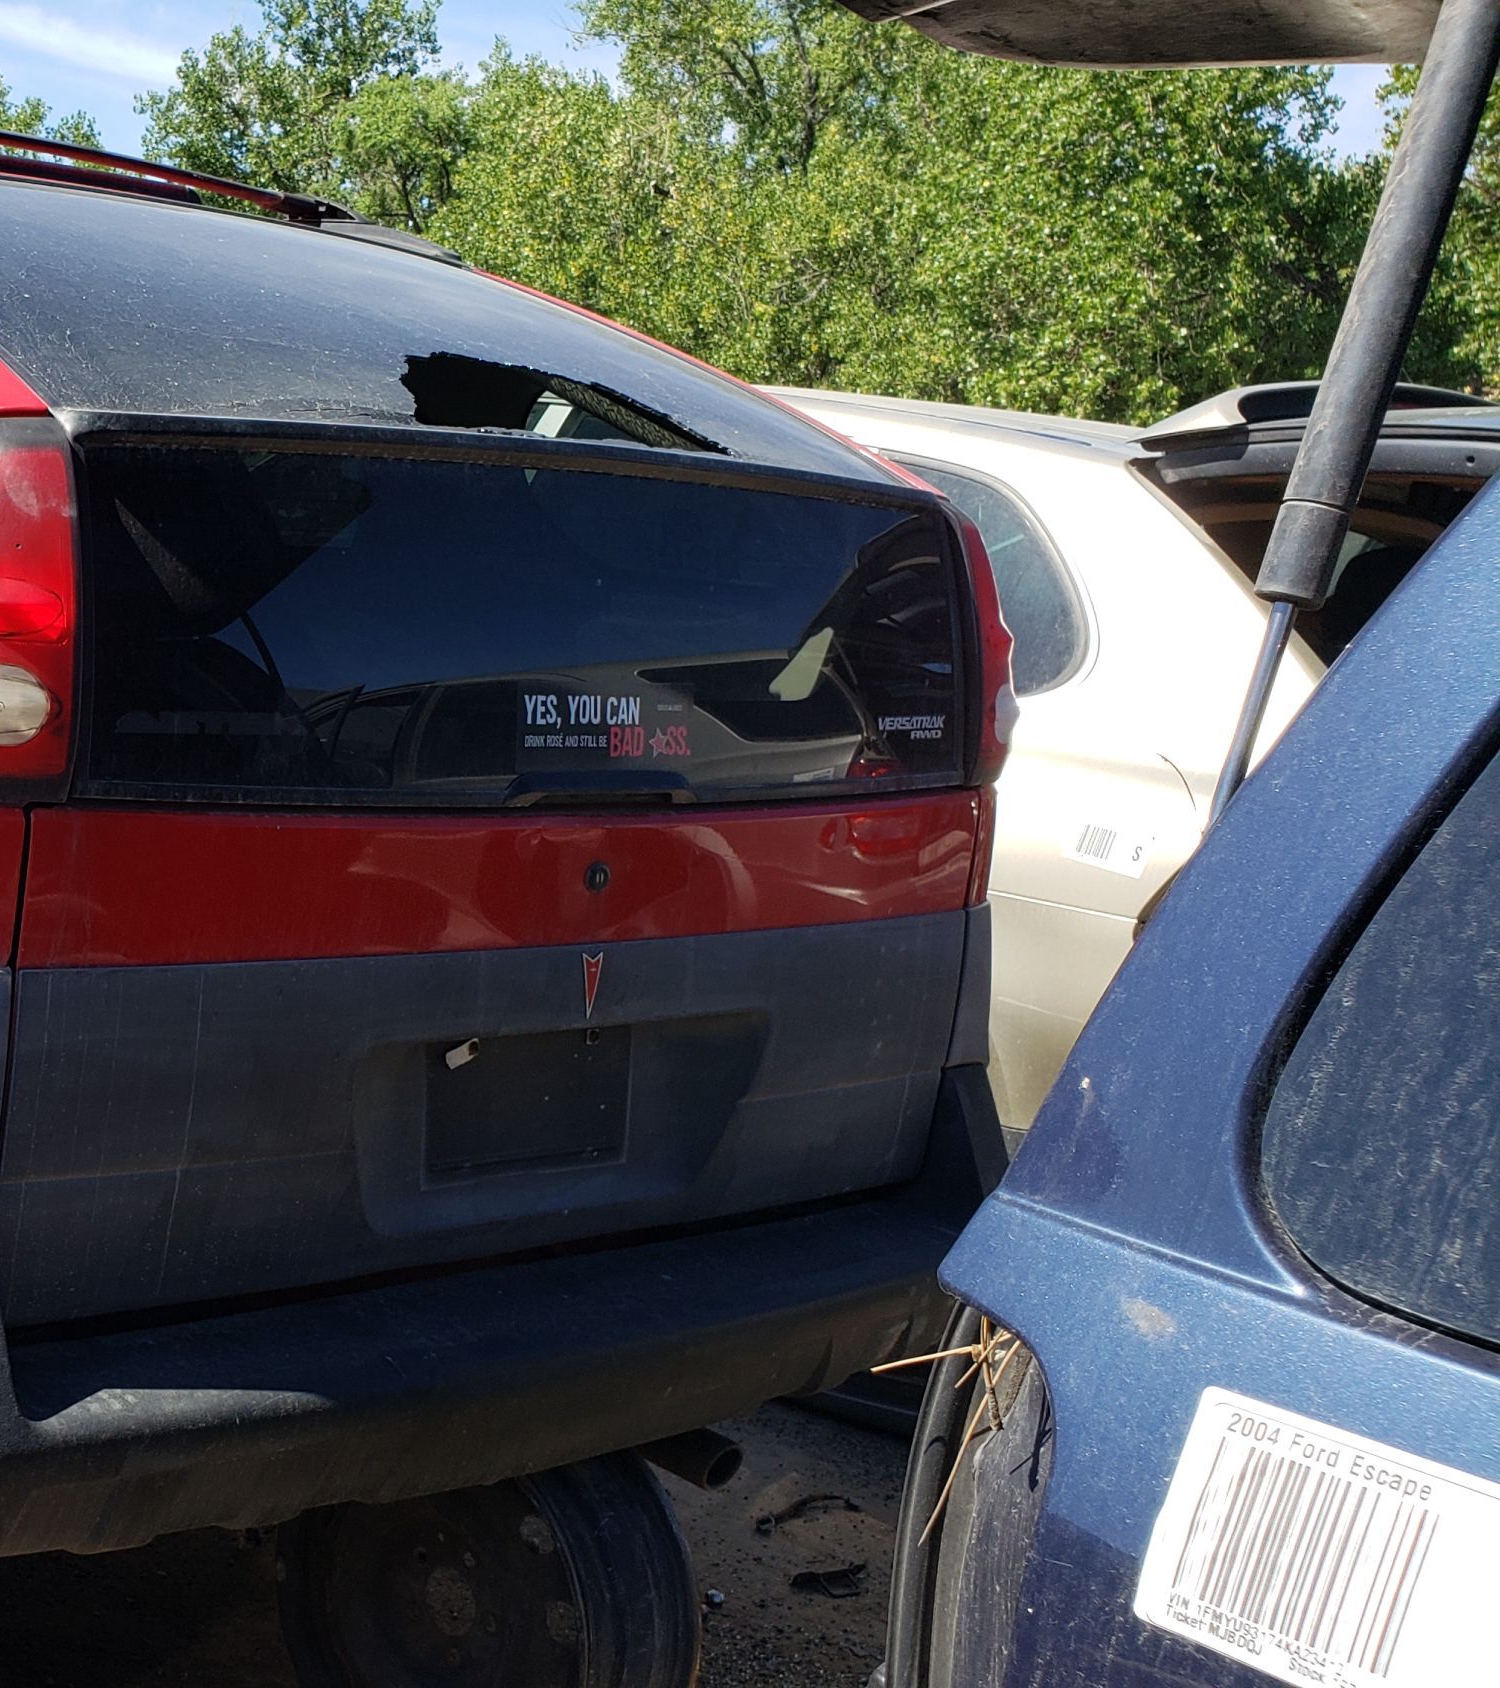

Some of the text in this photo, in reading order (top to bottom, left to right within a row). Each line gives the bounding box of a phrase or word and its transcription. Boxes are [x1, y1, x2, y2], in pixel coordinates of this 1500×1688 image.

[523, 694, 640, 729] YES, YOU CAN
[878, 715, 946, 730] VERSATRAK
[524, 735, 545, 748] DRINK
[564, 735, 578, 748] AND
[580, 735, 597, 748] STILL
[598, 735, 608, 748] BE
[610, 726, 645, 757] BAD
[910, 730, 942, 739] AWD
[1226, 1412, 1432, 1501] 2004 Ford Escape
[1169, 1593, 1190, 1611] VIN
[1166, 1603, 1207, 1630] Ticket
